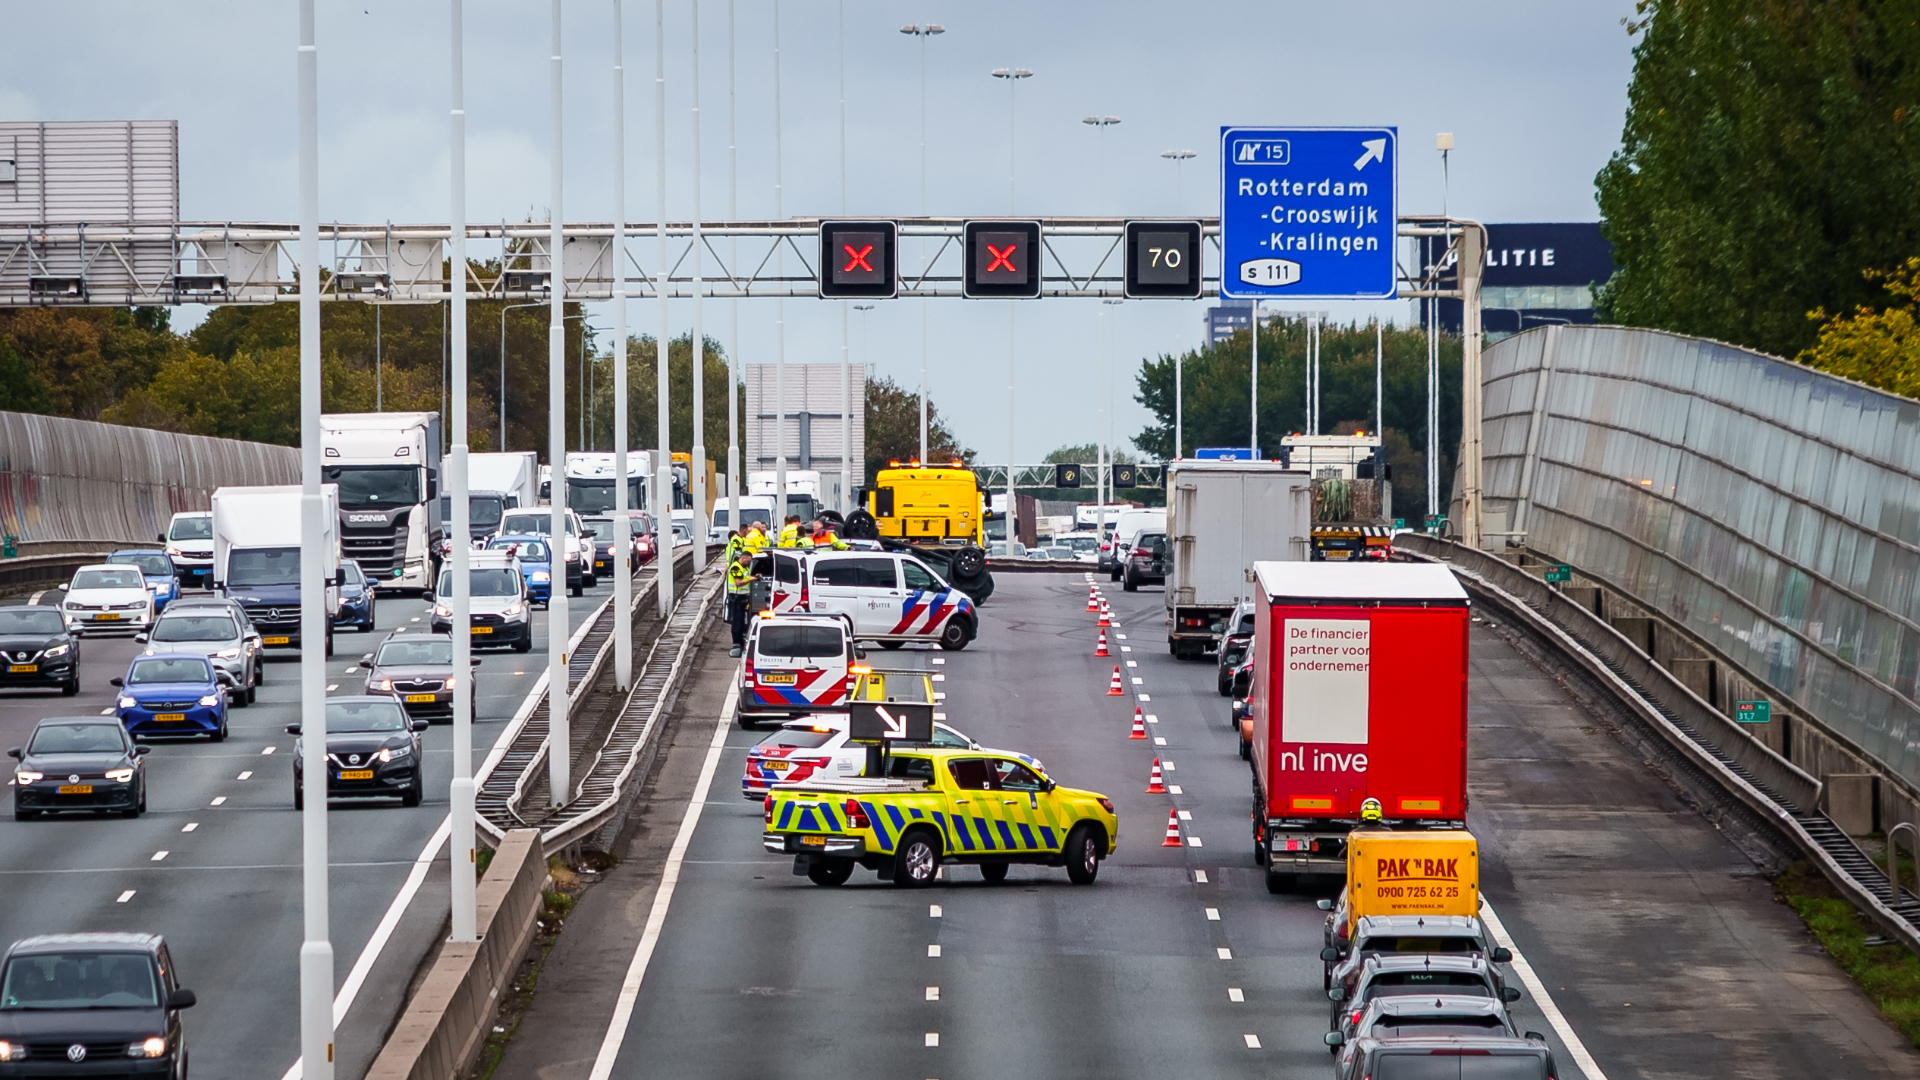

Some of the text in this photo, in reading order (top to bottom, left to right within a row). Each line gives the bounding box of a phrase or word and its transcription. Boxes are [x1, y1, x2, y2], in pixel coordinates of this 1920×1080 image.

[1265, 145, 1283, 159] 15
[1238, 178, 1368, 196] Rotterdam
[1261, 205, 1378, 229] -Crooswijk
[1260, 232, 1378, 256] -Kralingen
[1149, 248, 1181, 268] 70
[1447, 249, 1555, 267] PLITIE
[1267, 265, 1289, 280] 111
[349, 514, 388, 523] SCANIA
[1291, 628, 1368, 640] De financier
[1290, 645, 1370, 657] partner voor
[1738, 712, 1755, 720] 31,7
[1281, 746, 1368, 772] nl inve
[1377, 858, 1410, 878] PAK
[1424, 858, 1458, 878] BAK
[1377, 886, 1459, 898] 0900 725 62 25
